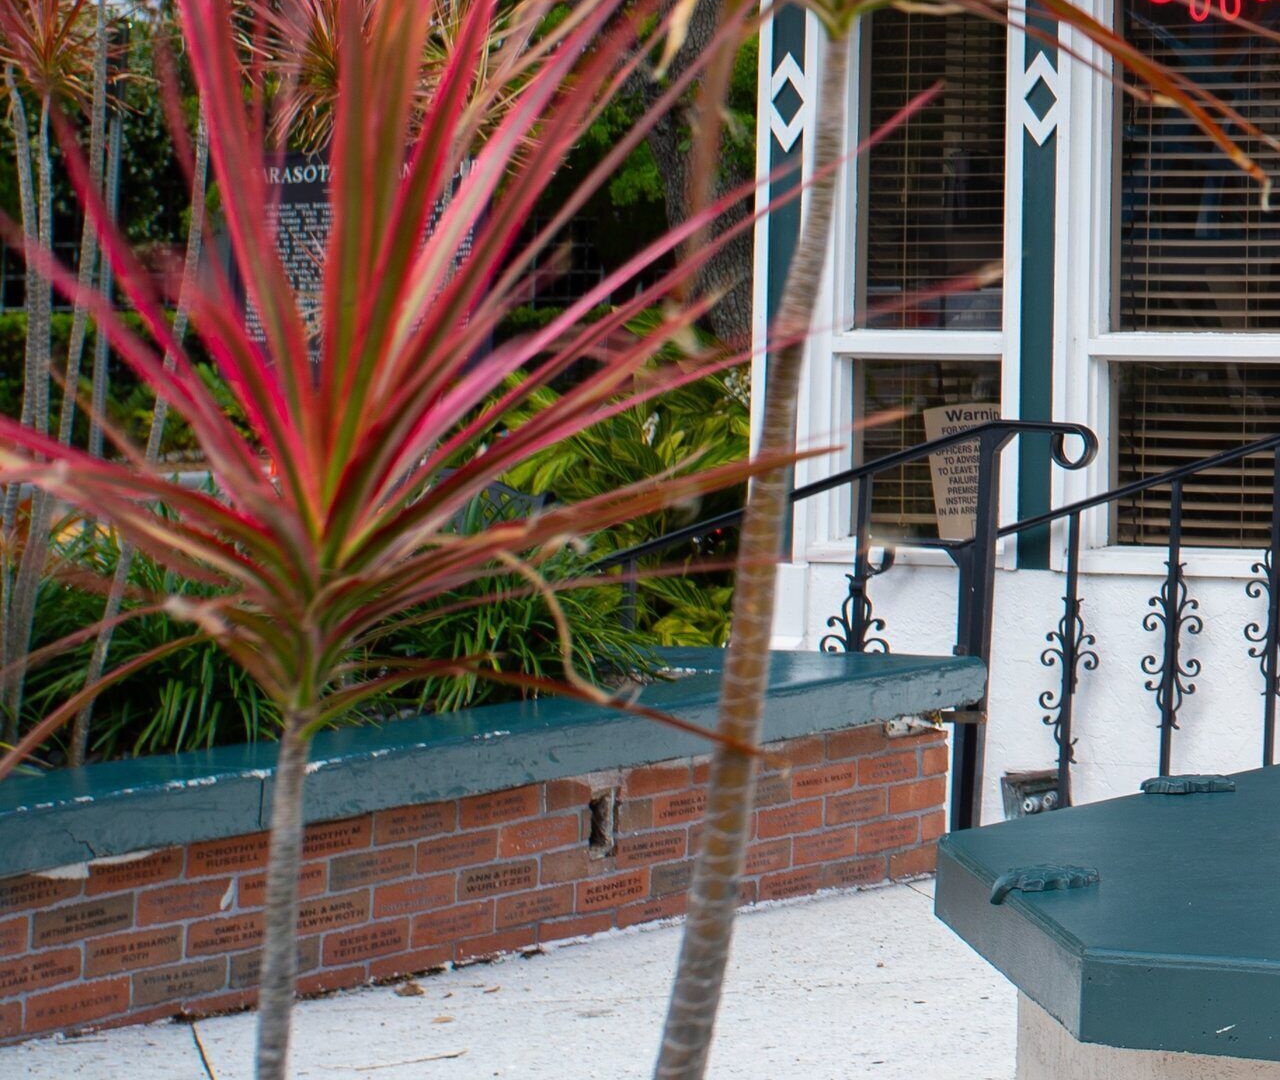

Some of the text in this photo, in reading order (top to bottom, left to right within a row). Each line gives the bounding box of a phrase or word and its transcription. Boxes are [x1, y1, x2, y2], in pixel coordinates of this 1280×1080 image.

[945, 408, 1001, 422] Warnin
[941, 425, 957, 435] FOR
[944, 457, 955, 465] TO
[938, 467, 949, 476] TO
[951, 466, 973, 475] LEAVE
[946, 496, 977, 505] INSTRUC
[938, 507, 947, 516] IN
[948, 506, 959, 515] AN
[302, 828, 350, 844] OROTHY
[196, 843, 256, 860] DOROTHY
[302, 838, 352, 853] RUSSELL
[96, 857, 157, 876] DOROTHY
[206, 854, 258, 869] RUSSELL
[467, 872, 491, 884] ANN
[502, 865, 532, 878] FRED
[466, 875, 531, 893] WURLITZER
[586, 877, 642, 896] KENNETH
[585, 885, 643, 905] WOLFORD
[329, 901, 353, 912] MRS.
[335, 909, 365, 921] ROTH
[94, 944, 127, 958] JAMES
[136, 935, 178, 949] SHARON
